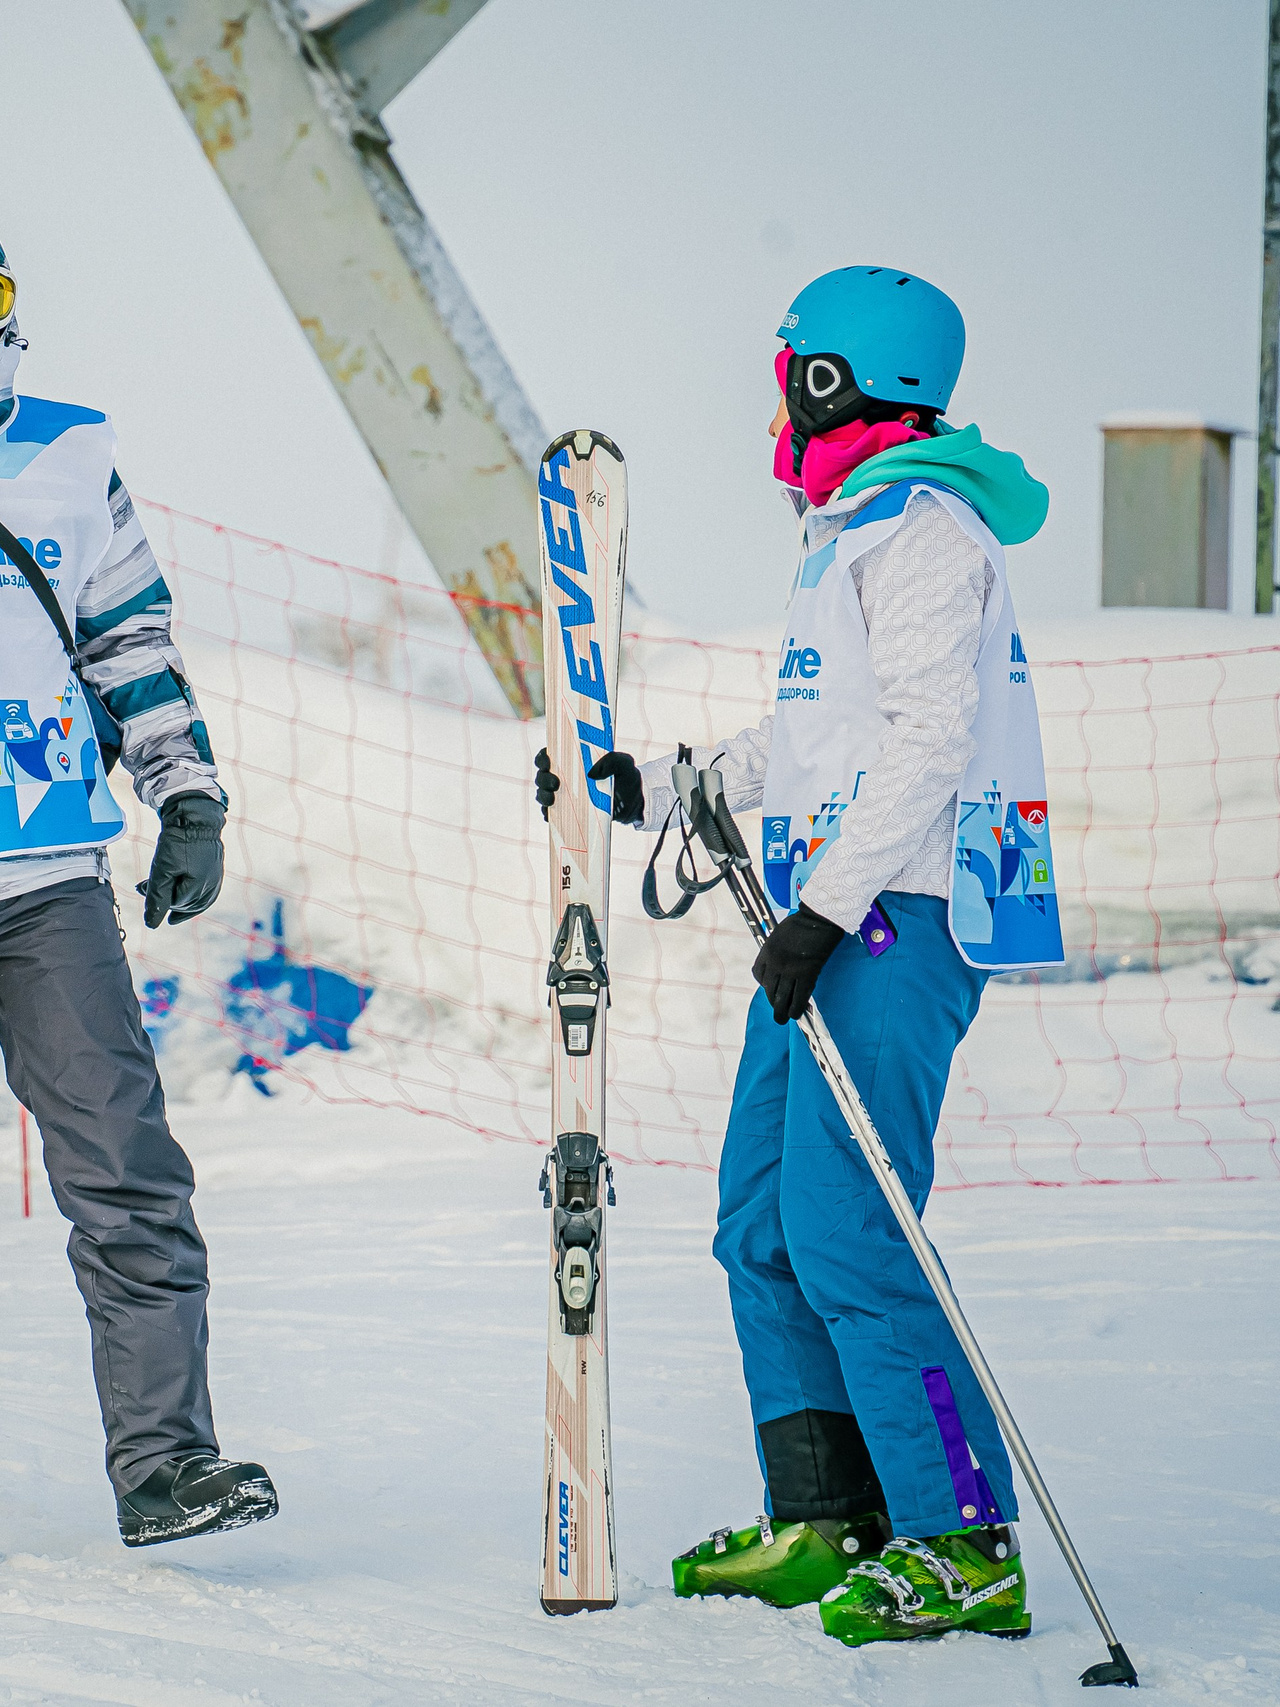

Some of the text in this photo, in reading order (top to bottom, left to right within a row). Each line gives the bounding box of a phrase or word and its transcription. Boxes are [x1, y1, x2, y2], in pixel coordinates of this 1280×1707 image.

[585, 489, 607, 508] 156
[538, 447, 615, 816] CLEVER
[562, 865, 571, 890] 156
[558, 1480, 569, 1577] CLEVER
[961, 1572, 1020, 1613] ROSSIGNOL
